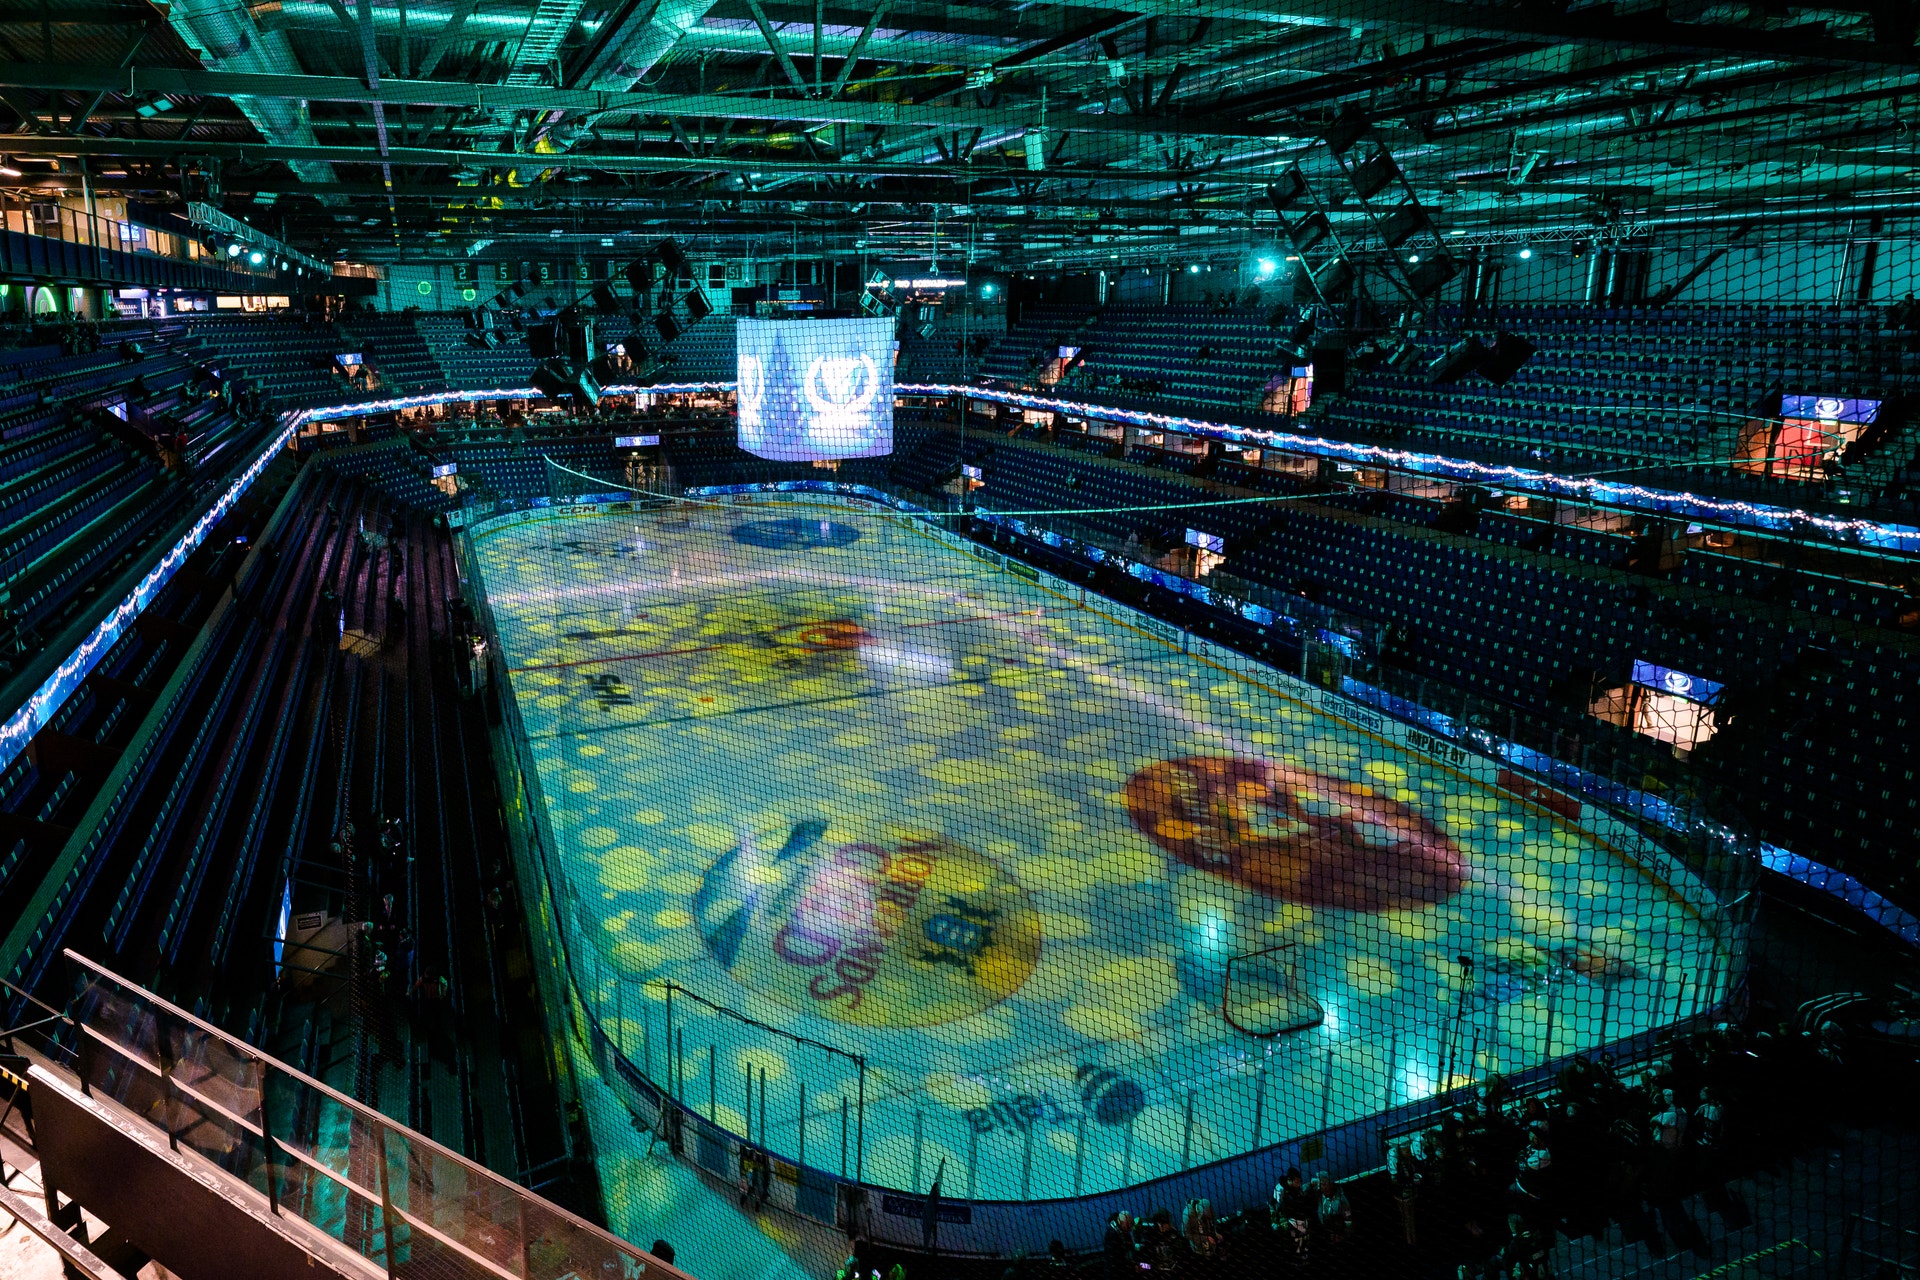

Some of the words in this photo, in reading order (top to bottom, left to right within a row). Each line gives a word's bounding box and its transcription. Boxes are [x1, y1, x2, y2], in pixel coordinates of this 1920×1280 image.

[458, 267, 467, 280] 2
[500, 267, 508, 279] 5
[559, 505, 597, 515] CCM
[1408, 728, 1451, 758] IMPACT
